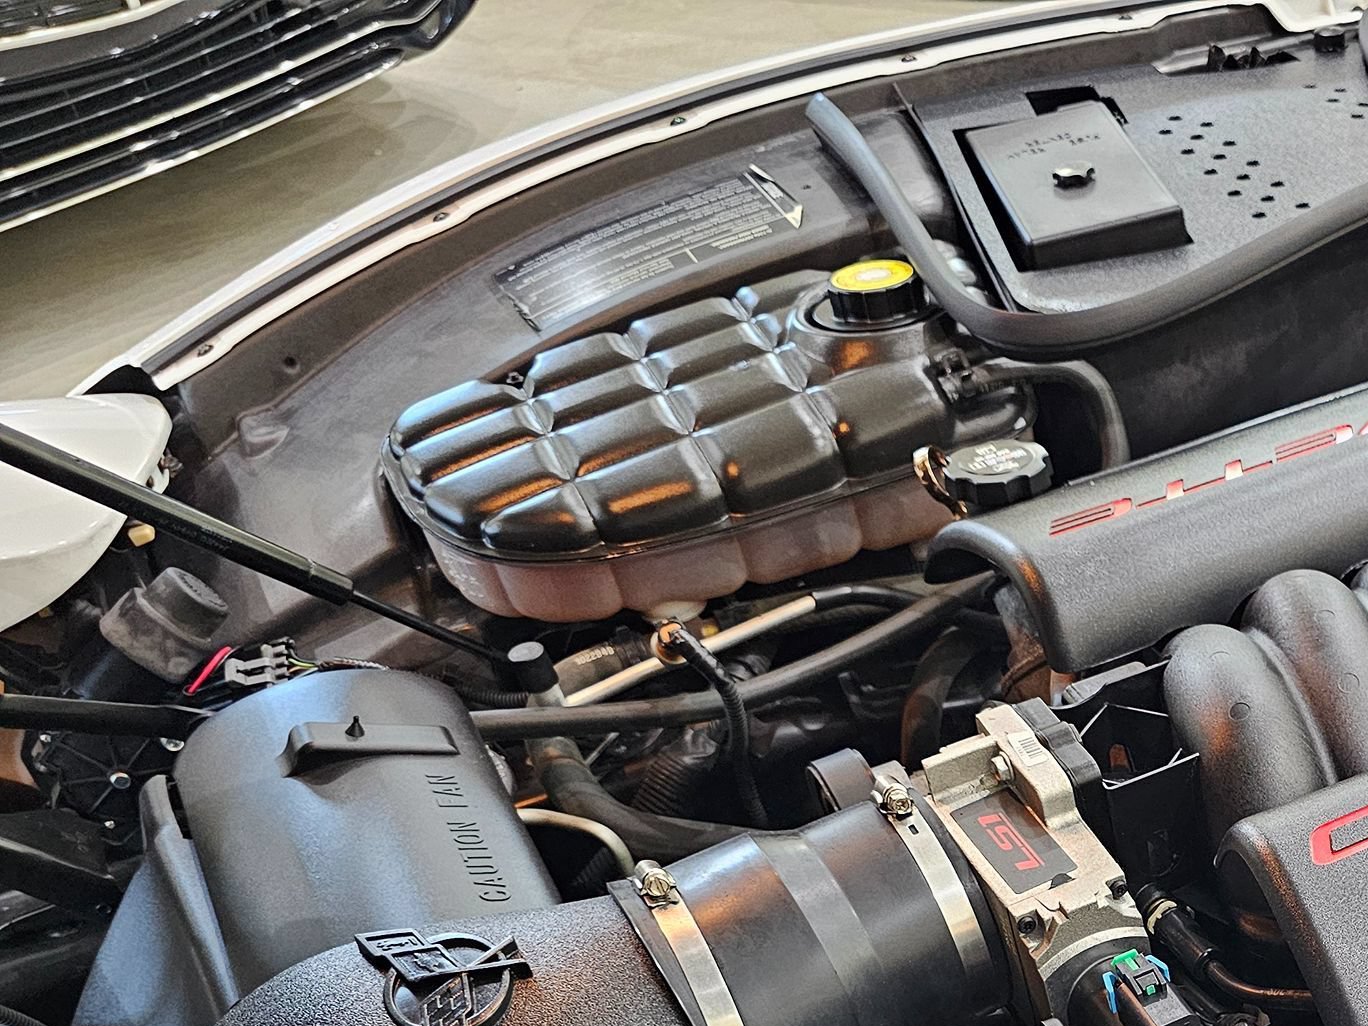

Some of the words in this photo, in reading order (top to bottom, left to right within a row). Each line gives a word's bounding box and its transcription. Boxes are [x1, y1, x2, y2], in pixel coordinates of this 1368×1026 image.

[424, 773, 469, 808] FAN
[446, 821, 512, 902] CAUTION
[977, 812, 1044, 871] LS1
